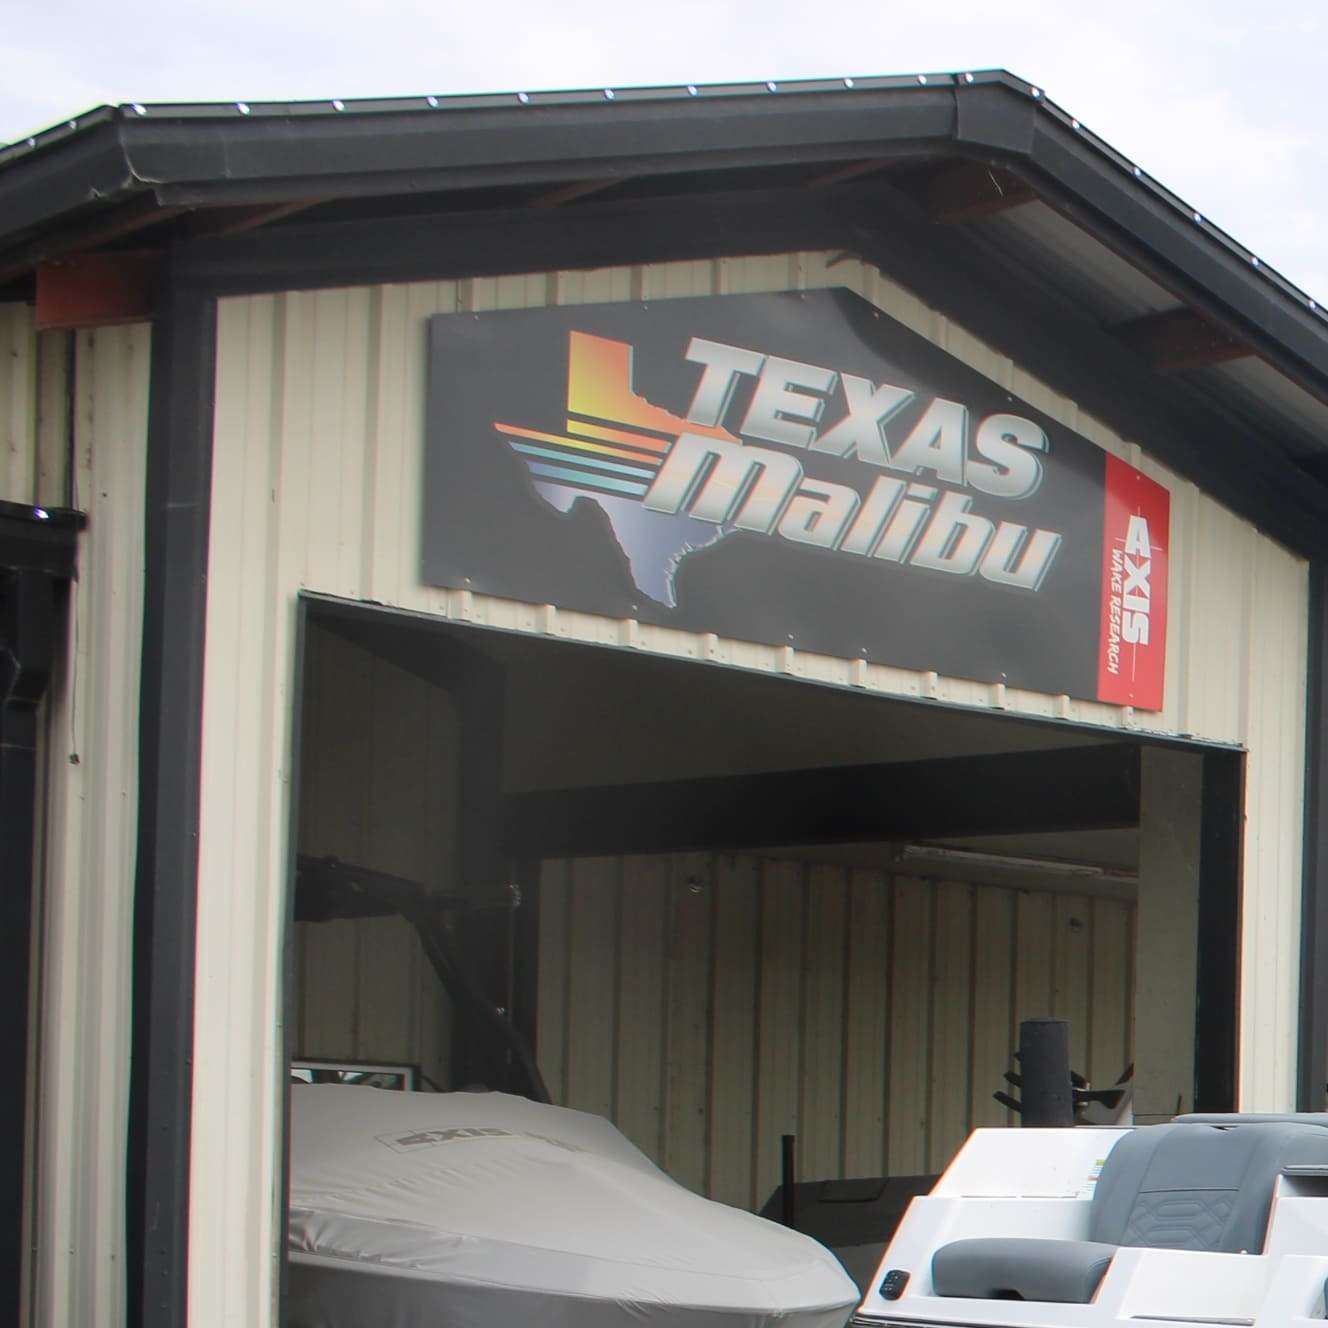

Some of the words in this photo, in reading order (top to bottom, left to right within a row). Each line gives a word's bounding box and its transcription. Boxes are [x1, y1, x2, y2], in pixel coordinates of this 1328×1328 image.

[685, 337, 1049, 499] TEXAS
[641, 432, 1062, 592] Malibu
[1111, 548, 1123, 593] WAKE
[1107, 595, 1122, 675] RESEARCH
[1122, 514, 1152, 645] AXIS
